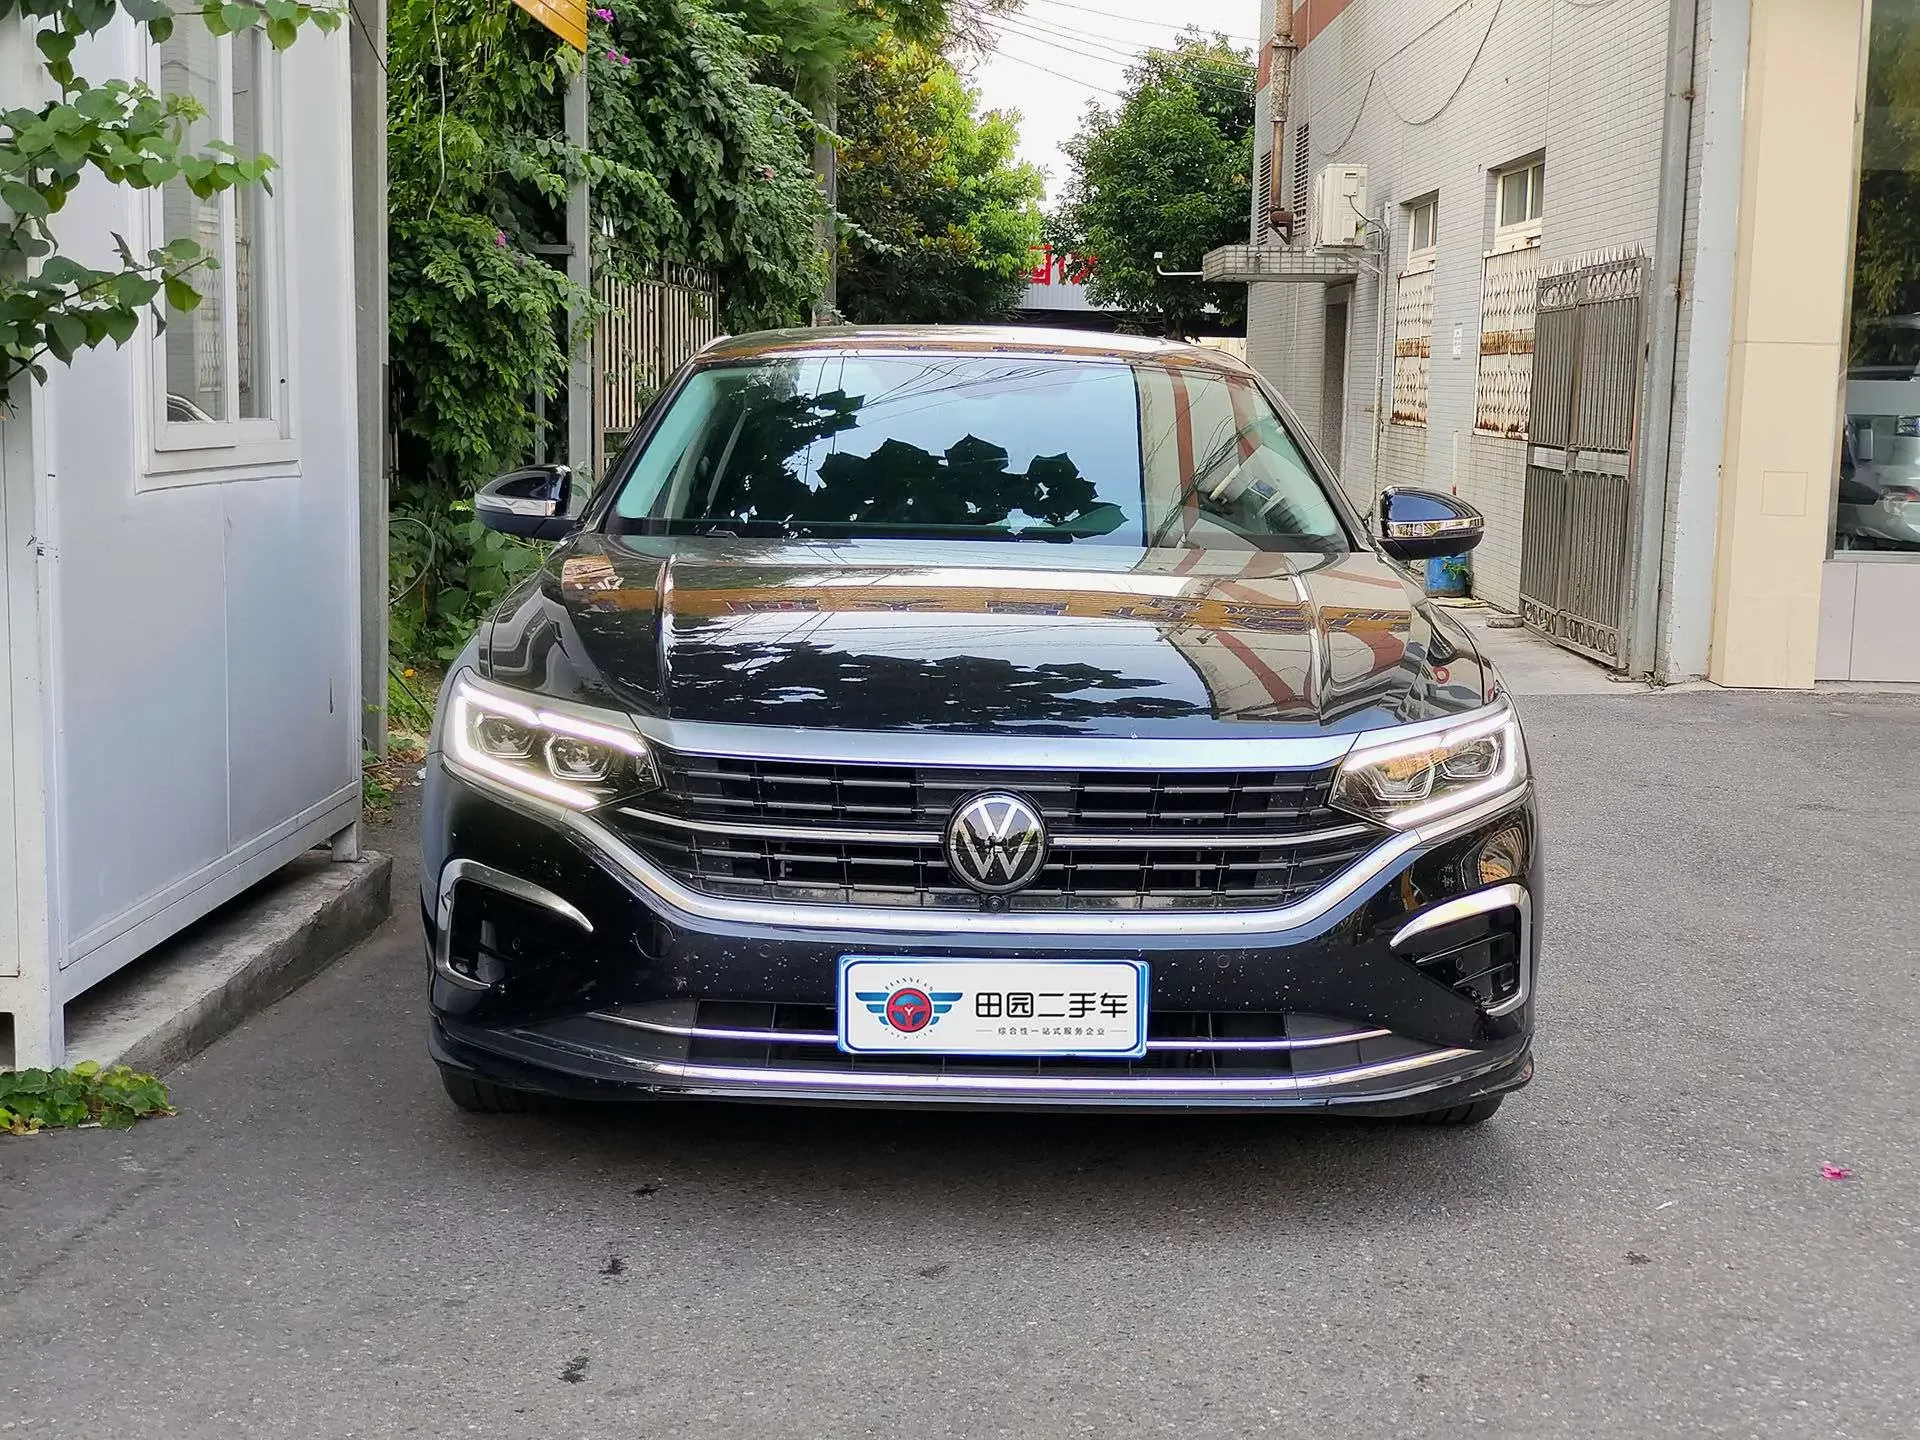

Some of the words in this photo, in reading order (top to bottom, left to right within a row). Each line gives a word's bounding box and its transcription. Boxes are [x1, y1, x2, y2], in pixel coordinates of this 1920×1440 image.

[951, 793, 1042, 886] VW
[975, 992, 1128, 1018] 田园二手车
[998, 1027, 1105, 1036] 综合性一站式服务企业
